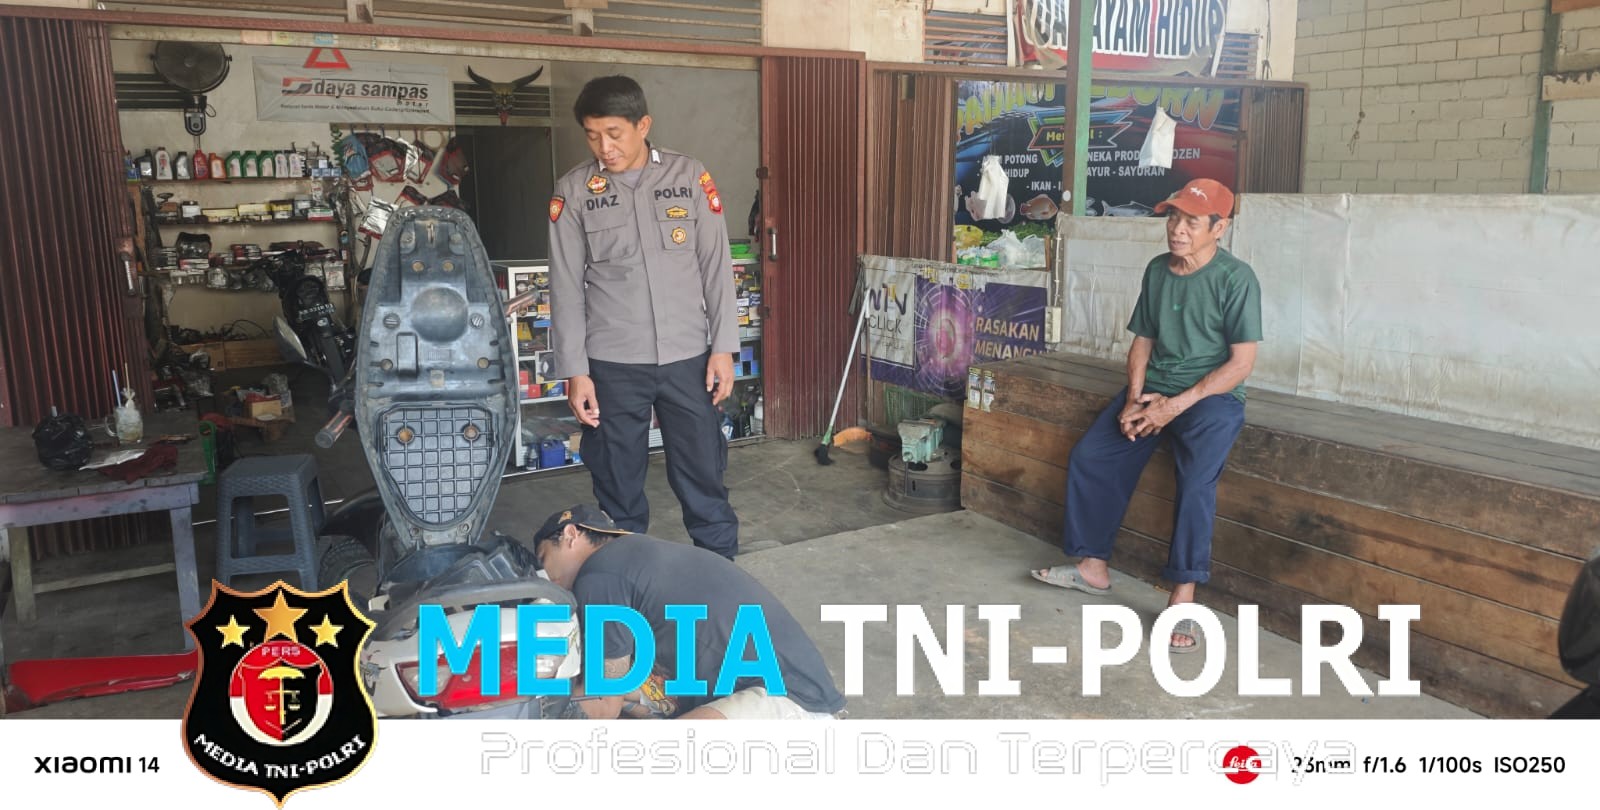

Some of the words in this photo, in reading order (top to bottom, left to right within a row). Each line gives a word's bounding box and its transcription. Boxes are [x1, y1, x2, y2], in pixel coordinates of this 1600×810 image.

[314, 79, 355, 98] daya
[361, 83, 429, 101] sampas
[1004, 154, 1038, 164] POTONG
[1115, 150, 1140, 161] PROD
[1031, 181, 1051, 191] IKAN
[654, 187, 693, 201] POLRI
[586, 195, 619, 211] DIAZ
[868, 314, 902, 335] CLICK
[975, 316, 1040, 342] RASAKAN
